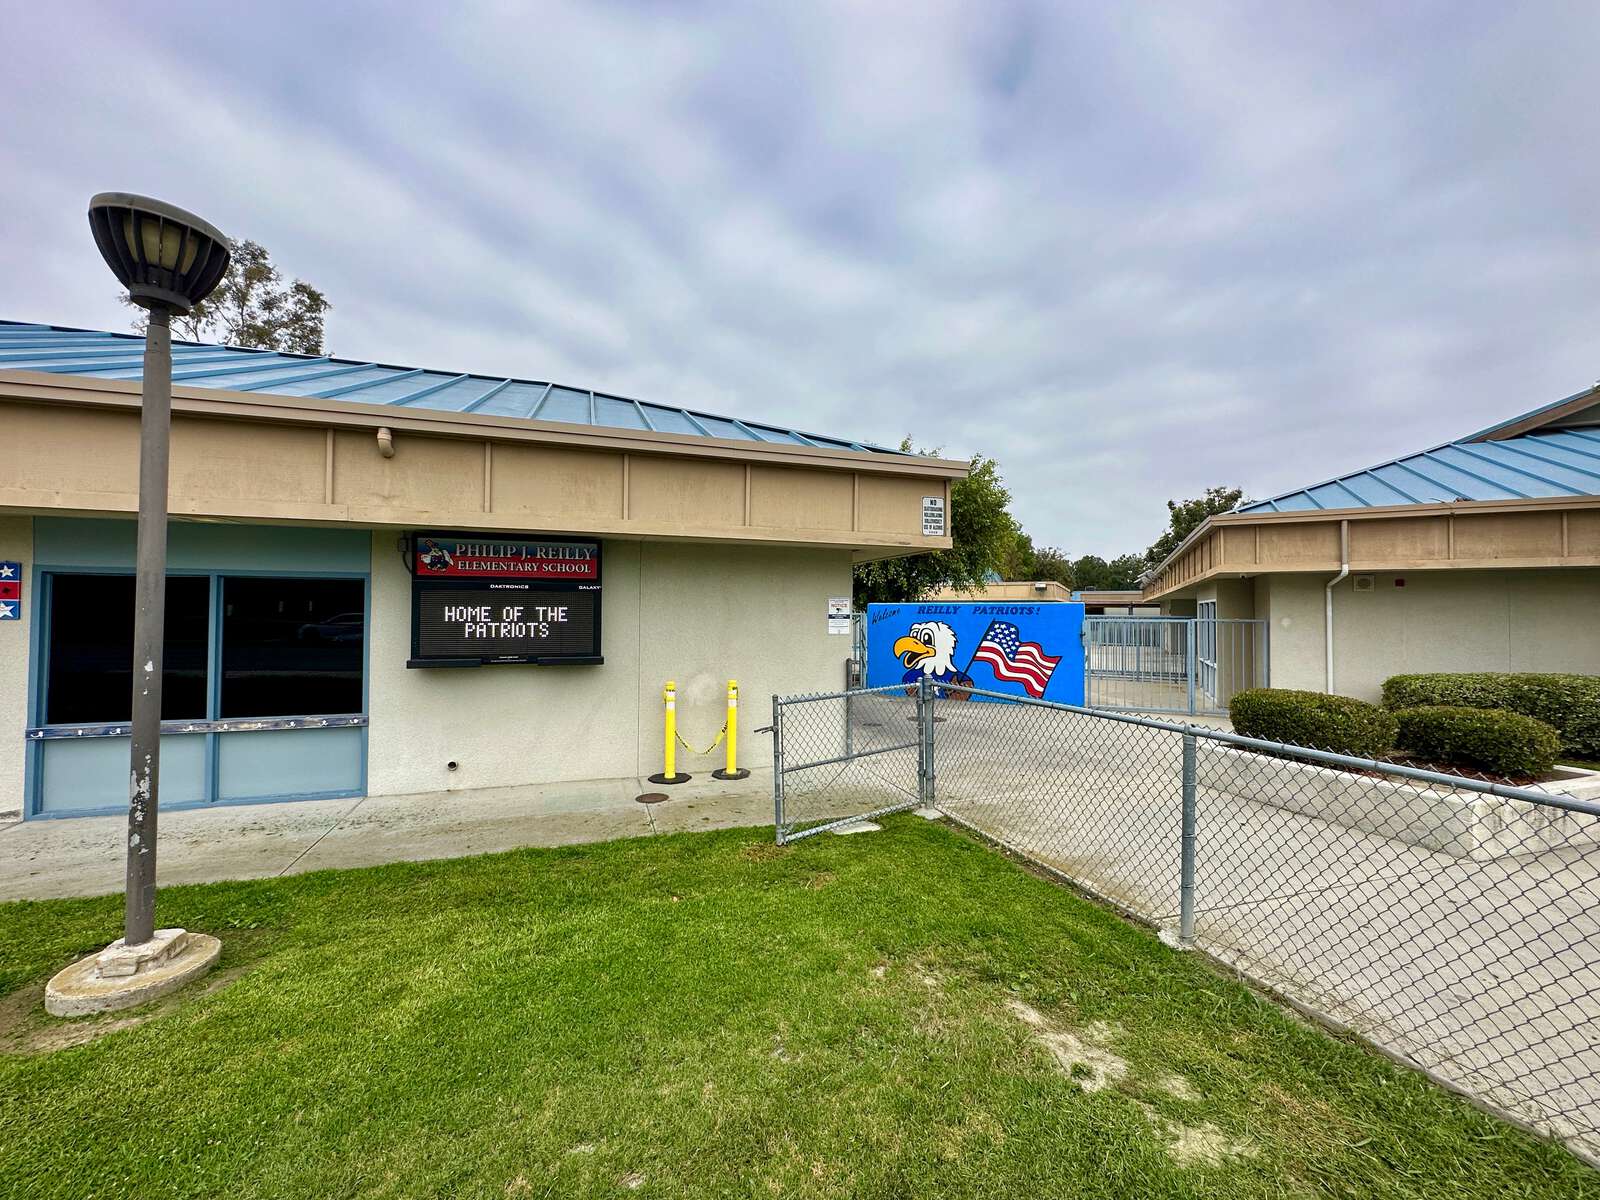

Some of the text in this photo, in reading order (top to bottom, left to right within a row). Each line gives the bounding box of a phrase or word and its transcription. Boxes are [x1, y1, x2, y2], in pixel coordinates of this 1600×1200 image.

[455, 543, 593, 560] PHILIP J. REILLY
[457, 560, 591, 573] ELEMENTARY SCHOOL
[444, 606, 568, 622] HOME OF THE
[917, 605, 1041, 616] REILLY PATRIOTS!
[465, 622, 549, 638] PATRIOTS
